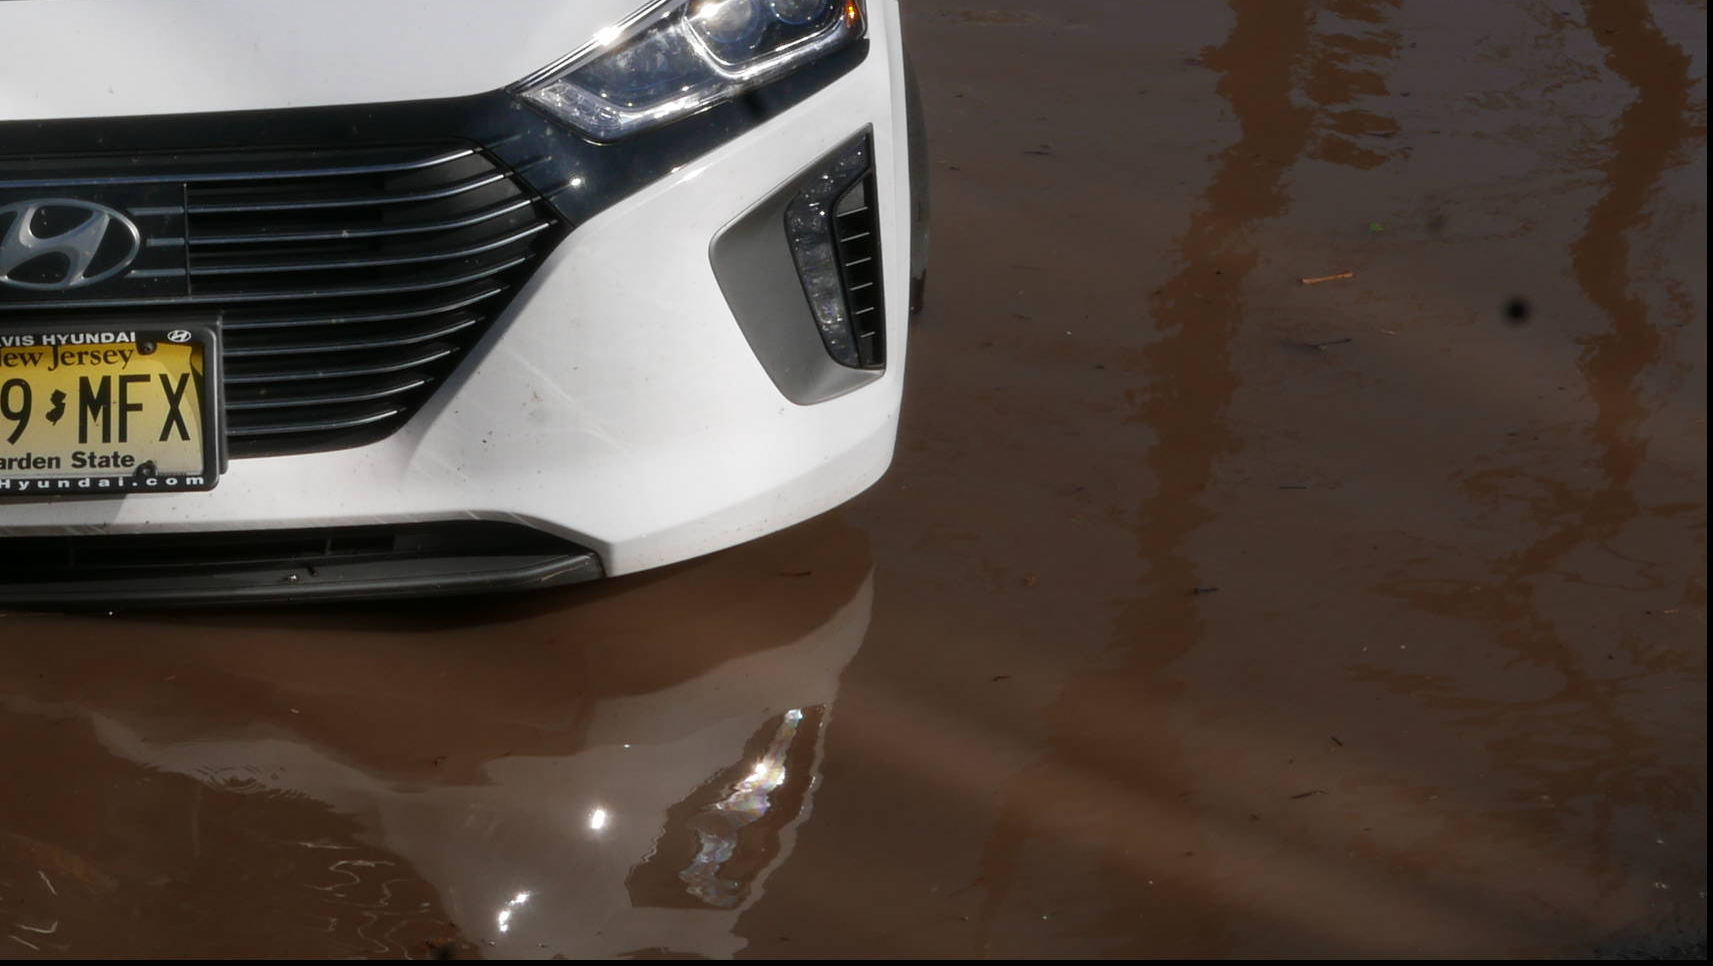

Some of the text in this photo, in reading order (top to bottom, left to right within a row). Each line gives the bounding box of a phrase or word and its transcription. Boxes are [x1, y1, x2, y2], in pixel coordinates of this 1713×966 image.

[42, 332, 137, 345] HYUNDAI
[48, 345, 134, 371] Jersey
[78, 373, 191, 444] MFX
[71, 451, 135, 469] State
